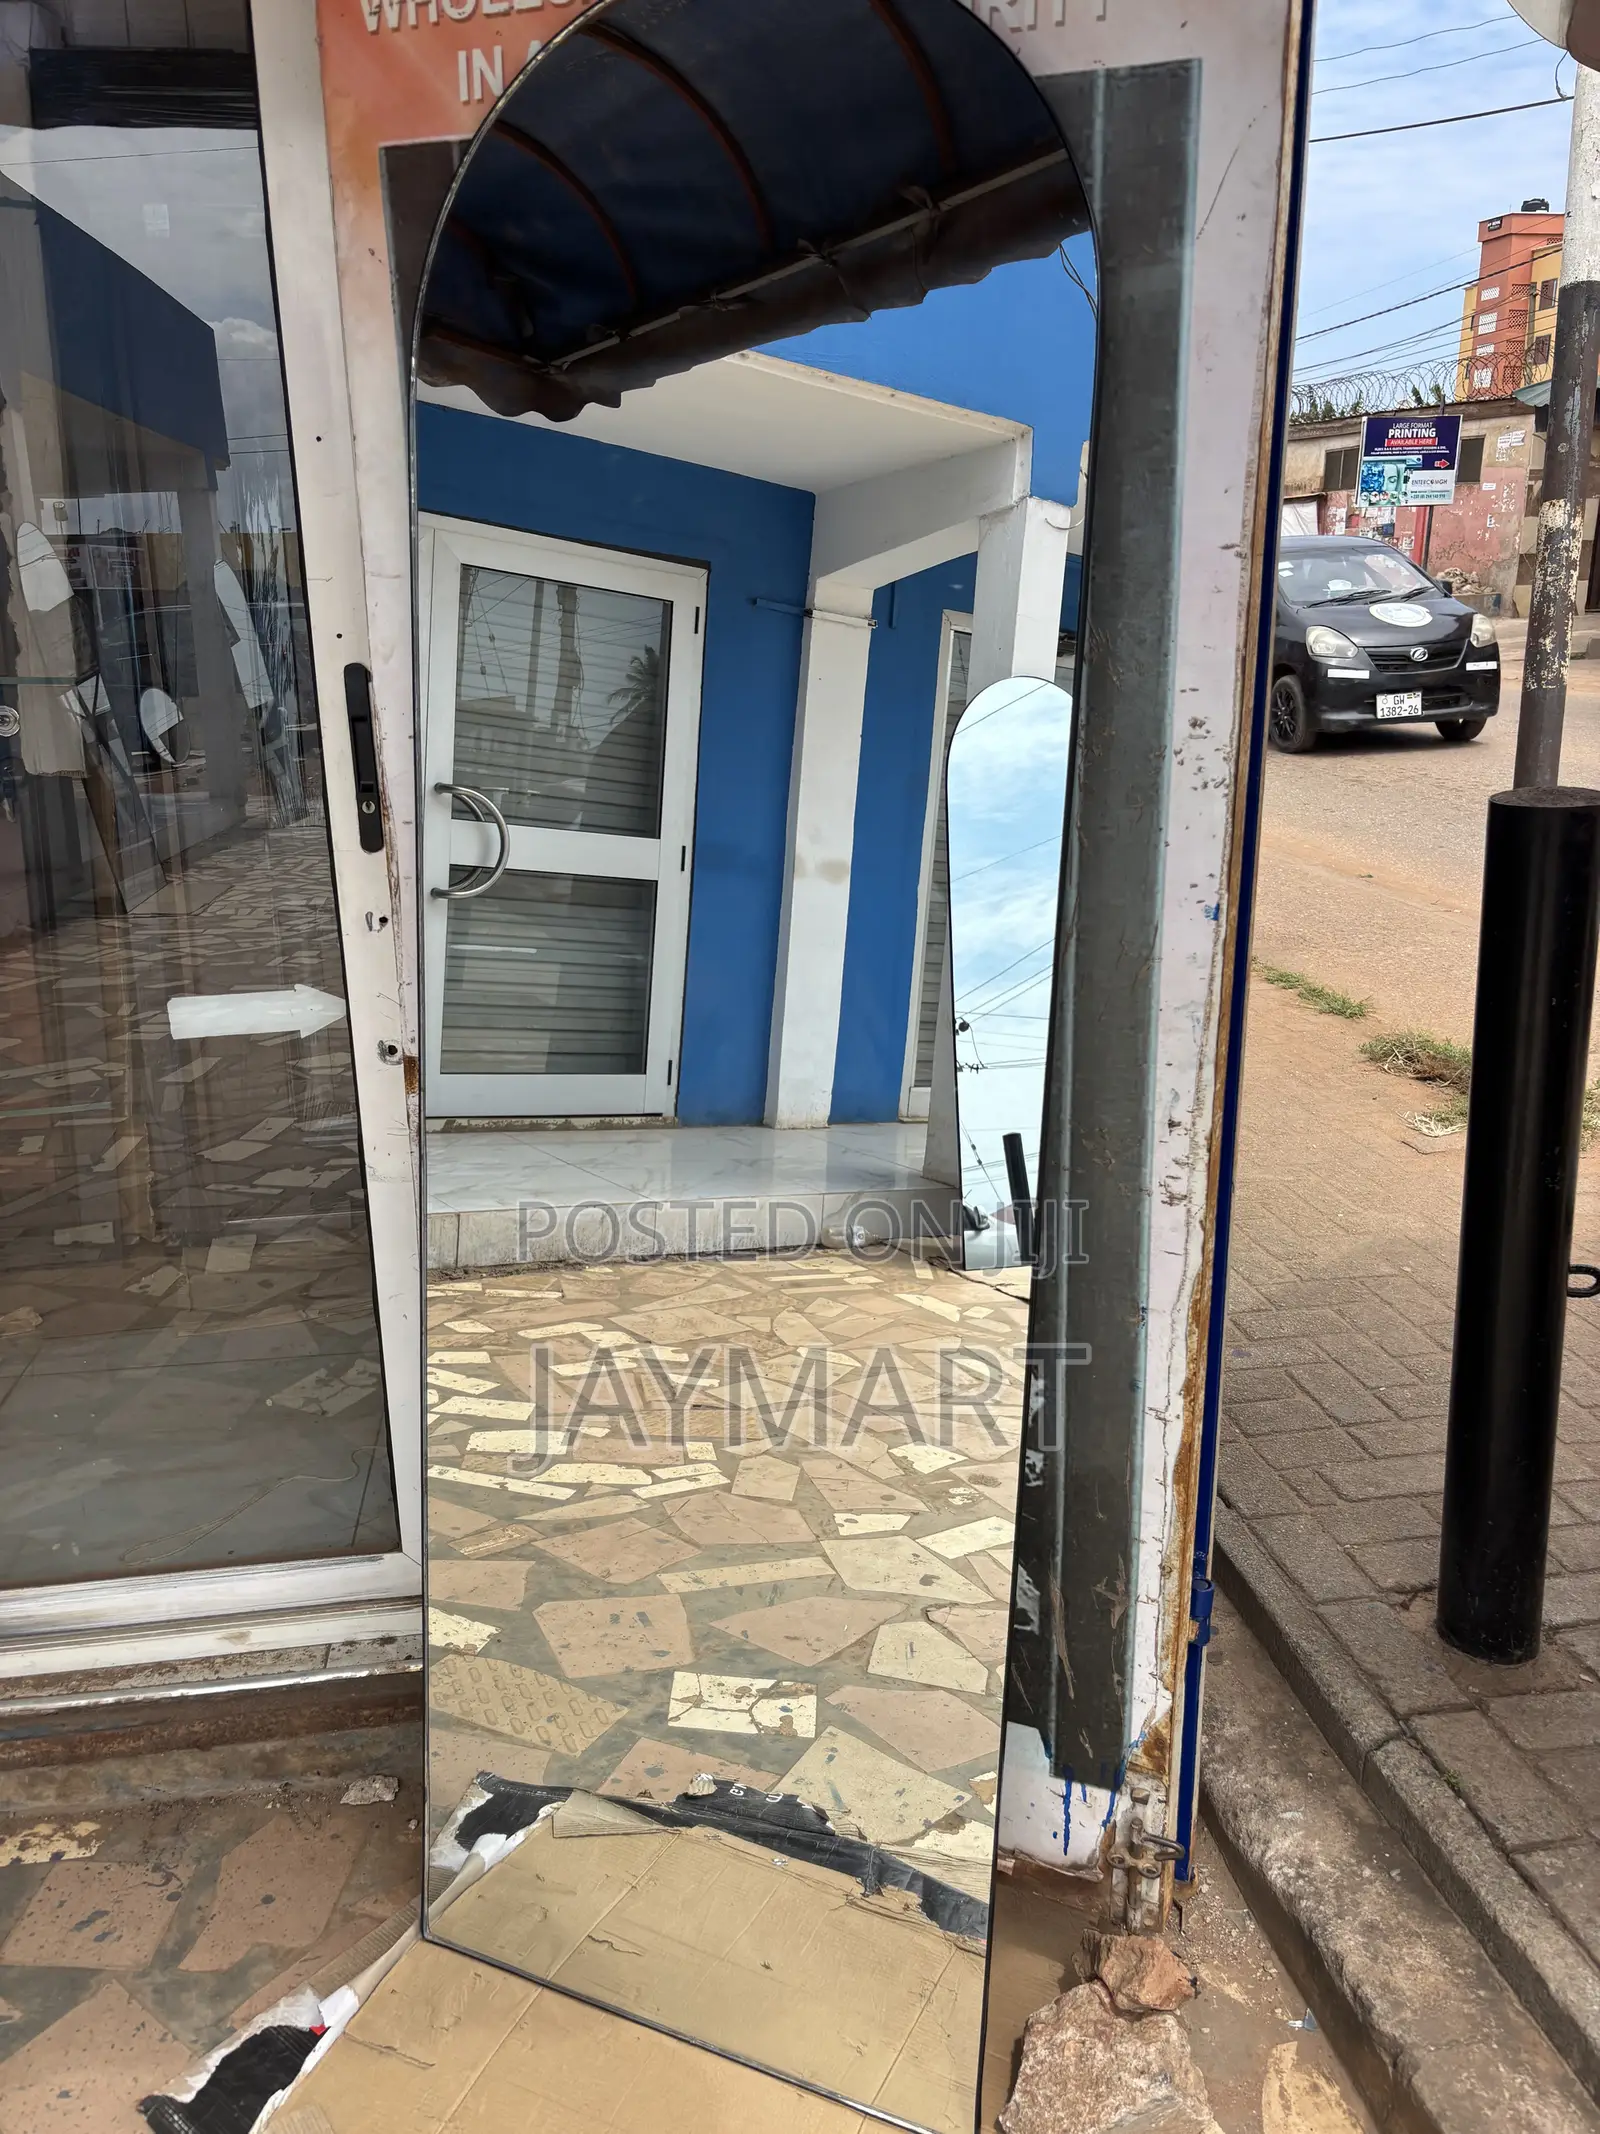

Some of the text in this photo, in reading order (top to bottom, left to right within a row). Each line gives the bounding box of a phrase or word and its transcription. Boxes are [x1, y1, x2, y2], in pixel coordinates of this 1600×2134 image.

[457, 45, 504, 103] IN
[1388, 428, 1436, 438] PRINTING
[1380, 705, 1419, 717] 1382-26
